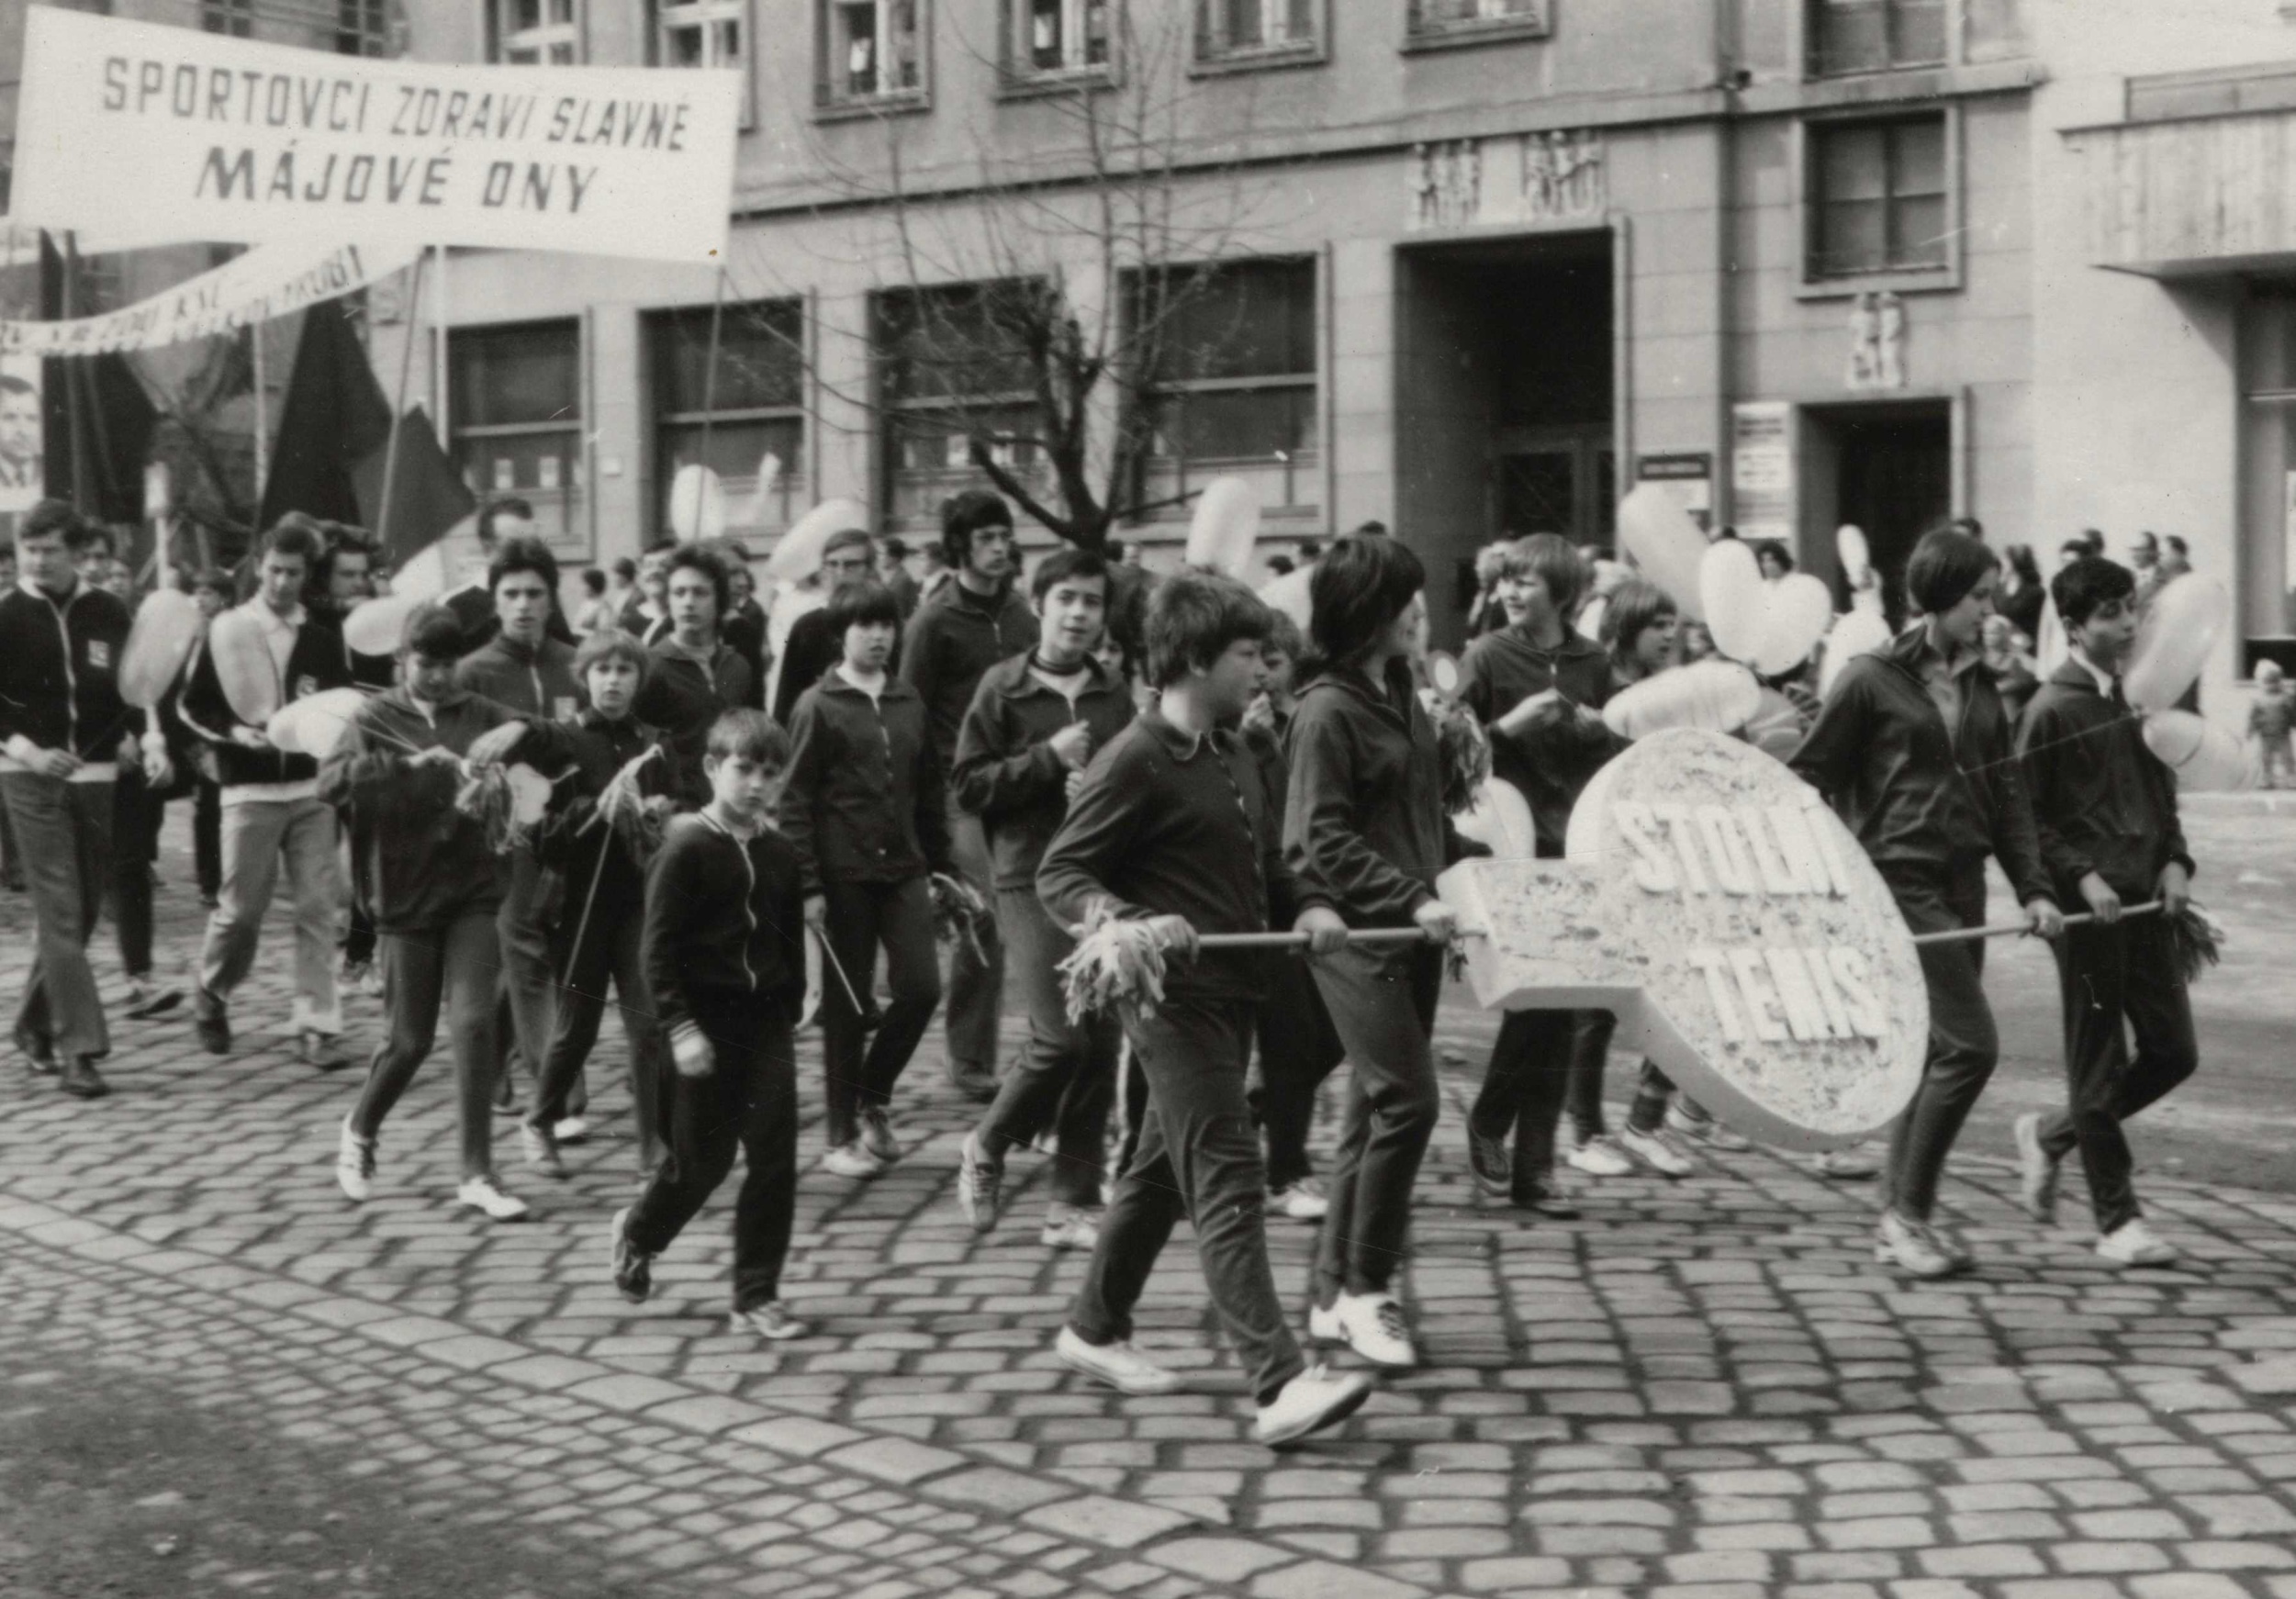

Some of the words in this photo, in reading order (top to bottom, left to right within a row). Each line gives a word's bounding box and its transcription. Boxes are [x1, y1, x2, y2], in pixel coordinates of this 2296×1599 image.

[102, 56, 370, 133] SPORTOVCI
[195, 138, 453, 205] MÁJOVÉ
[481, 161, 599, 214] DNY
[1686, 946, 1889, 1043] TENIS
